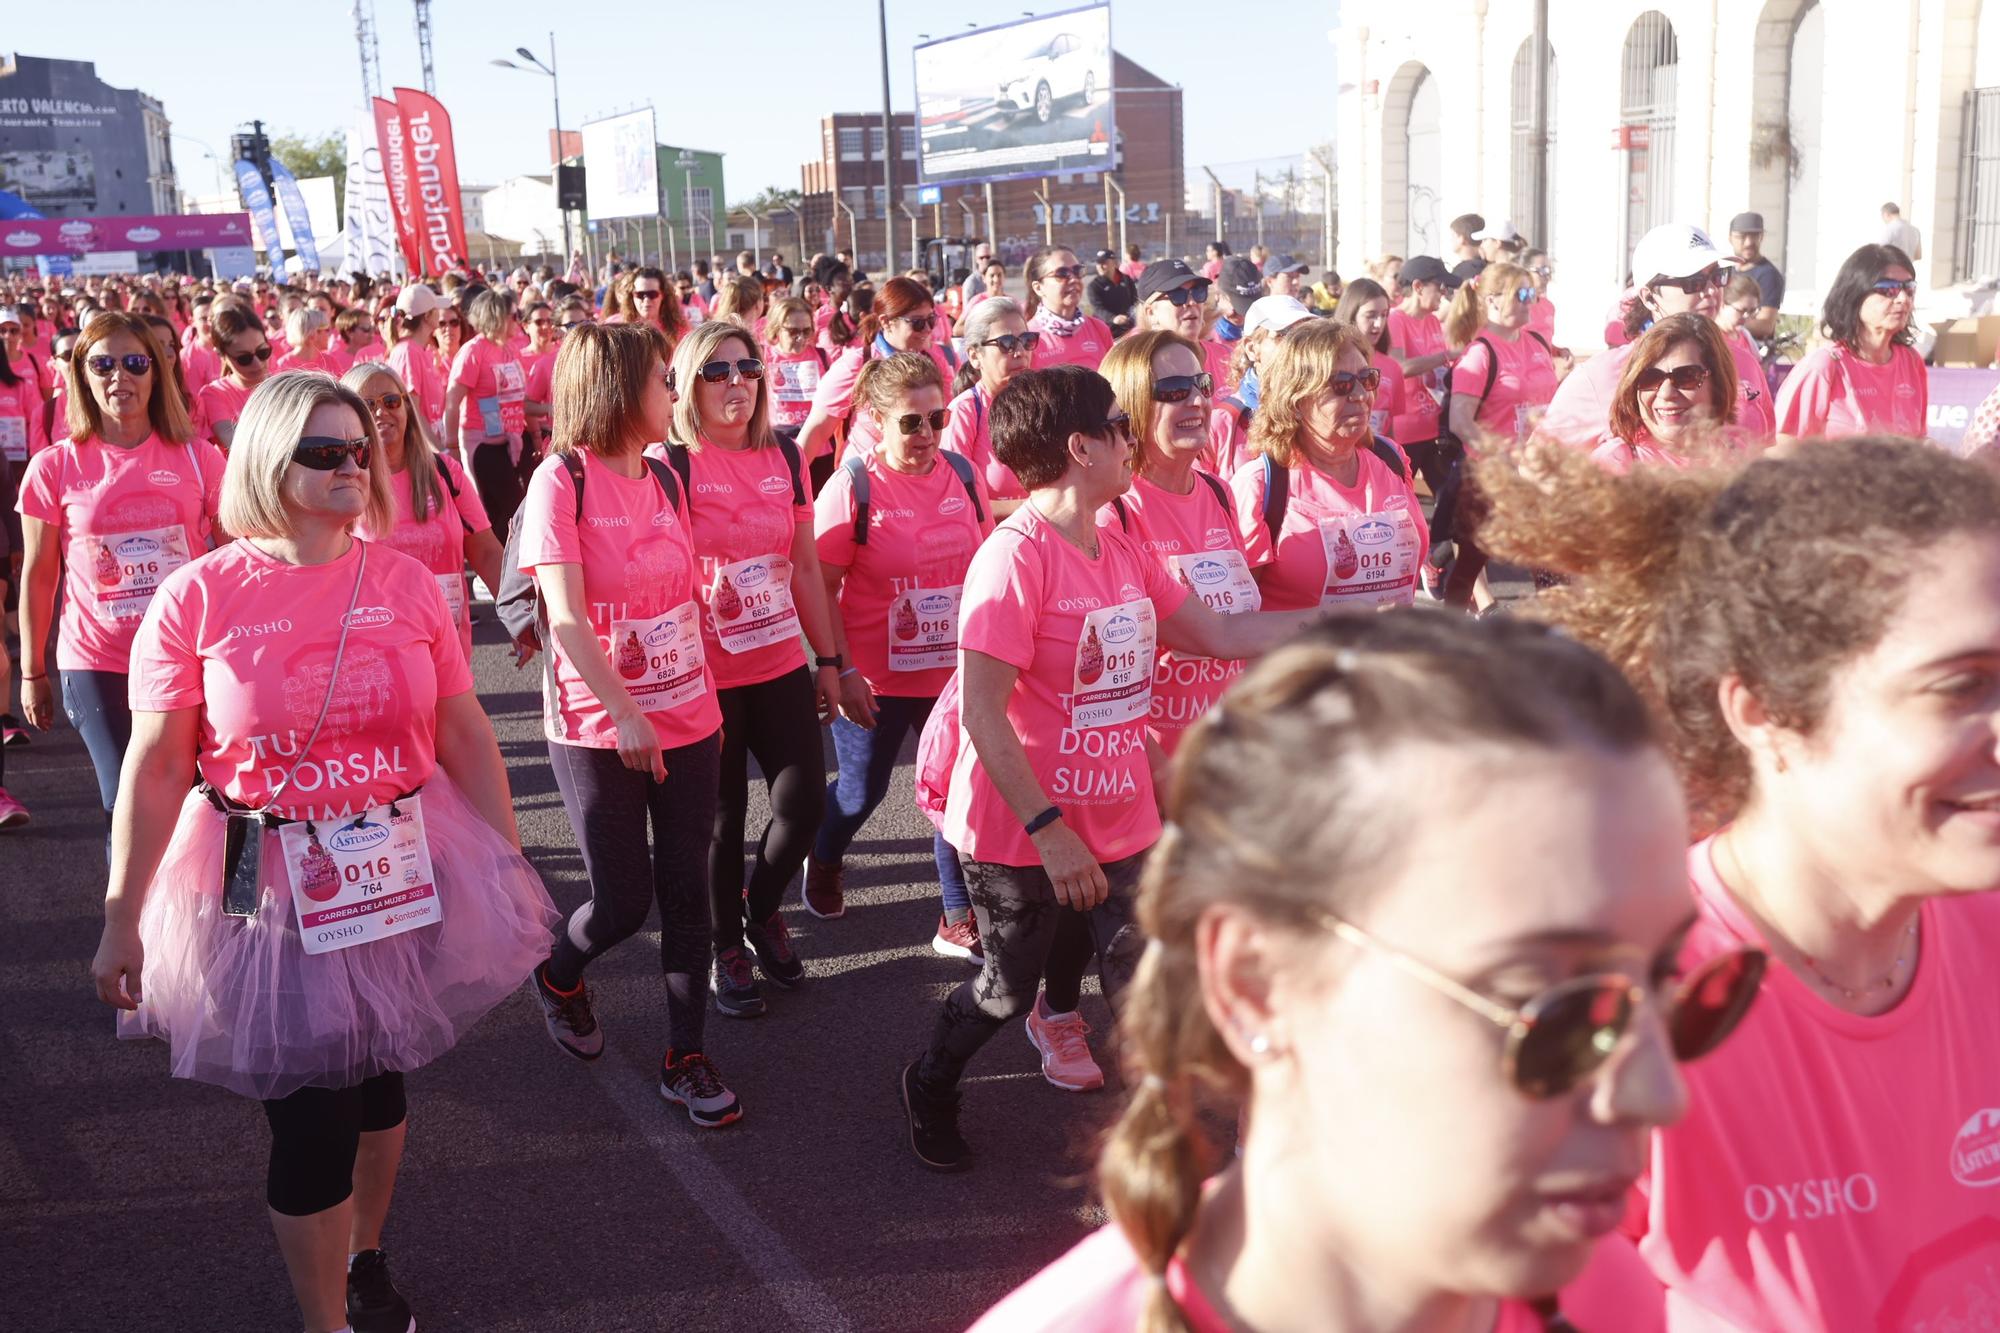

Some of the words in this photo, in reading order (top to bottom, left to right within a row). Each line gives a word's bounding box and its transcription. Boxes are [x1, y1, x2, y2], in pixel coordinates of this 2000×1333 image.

[0, 98, 29, 114] RTO
[1361, 552, 1392, 568] 016
[124, 561, 159, 577] 016
[1366, 570, 1385, 580] 6194
[133, 576, 154, 586] 6825
[744, 590, 771, 608] 016
[1058, 598, 1101, 612] OYSHO
[1203, 591, 1233, 608] 016
[752, 606, 770, 618] 6829
[227, 618, 293, 640] OYSHO
[921, 619, 949, 633] 016
[926, 633, 945, 642] 6827
[650, 649, 679, 670] 016
[1106, 650, 1136, 671] 016
[657, 667, 676, 680] 6828
[1112, 672, 1131, 684] 6197
[1153, 658, 1245, 687] DORSAL
[636, 697, 657, 707] SHO
[1081, 692, 1112, 703] CARRERA
[1112, 690, 1122, 698] DE
[1078, 707, 1113, 721] OYSHO
[247, 730, 298, 760] TU
[262, 746, 408, 793] DORSAL
[1052, 767, 1136, 796] SUMA
[390, 815, 414, 827] SUMA
[335, 830, 387, 848] ASTURIANA
[344, 856, 391, 883] 016
[361, 881, 383, 897] 764
[318, 906, 359, 923] CARRERA
[360, 903, 373, 912] DE
[373, 900, 384, 909] LA
[384, 894, 407, 907] MUJER
[408, 888, 425, 899] 2023
[394, 905, 432, 924] Santander
[317, 923, 364, 943] OYSHO
[1744, 1173, 1878, 1223] OYSHO
